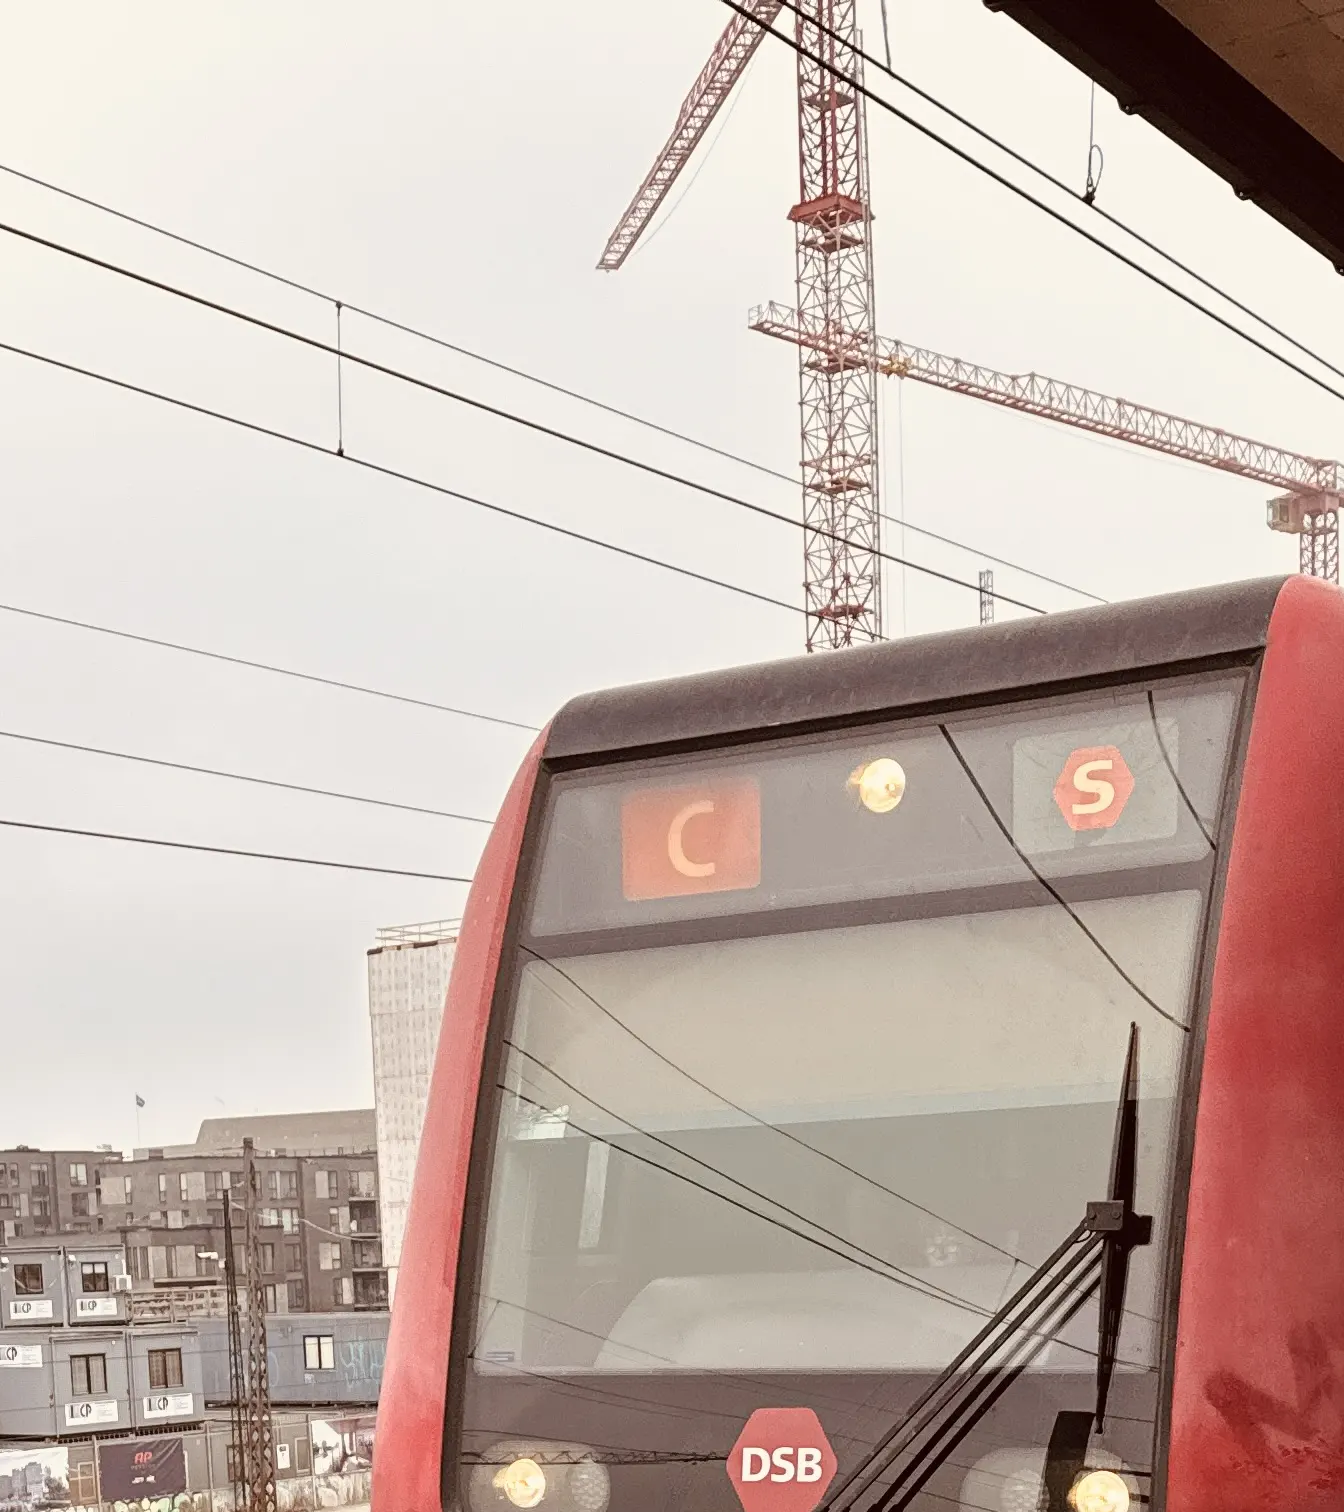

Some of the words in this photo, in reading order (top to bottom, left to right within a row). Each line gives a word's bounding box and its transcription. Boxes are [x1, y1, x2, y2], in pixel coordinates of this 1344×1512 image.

[1071, 758, 1115, 816] S
[666, 799, 717, 879] C
[740, 1445, 824, 1484] DSB
